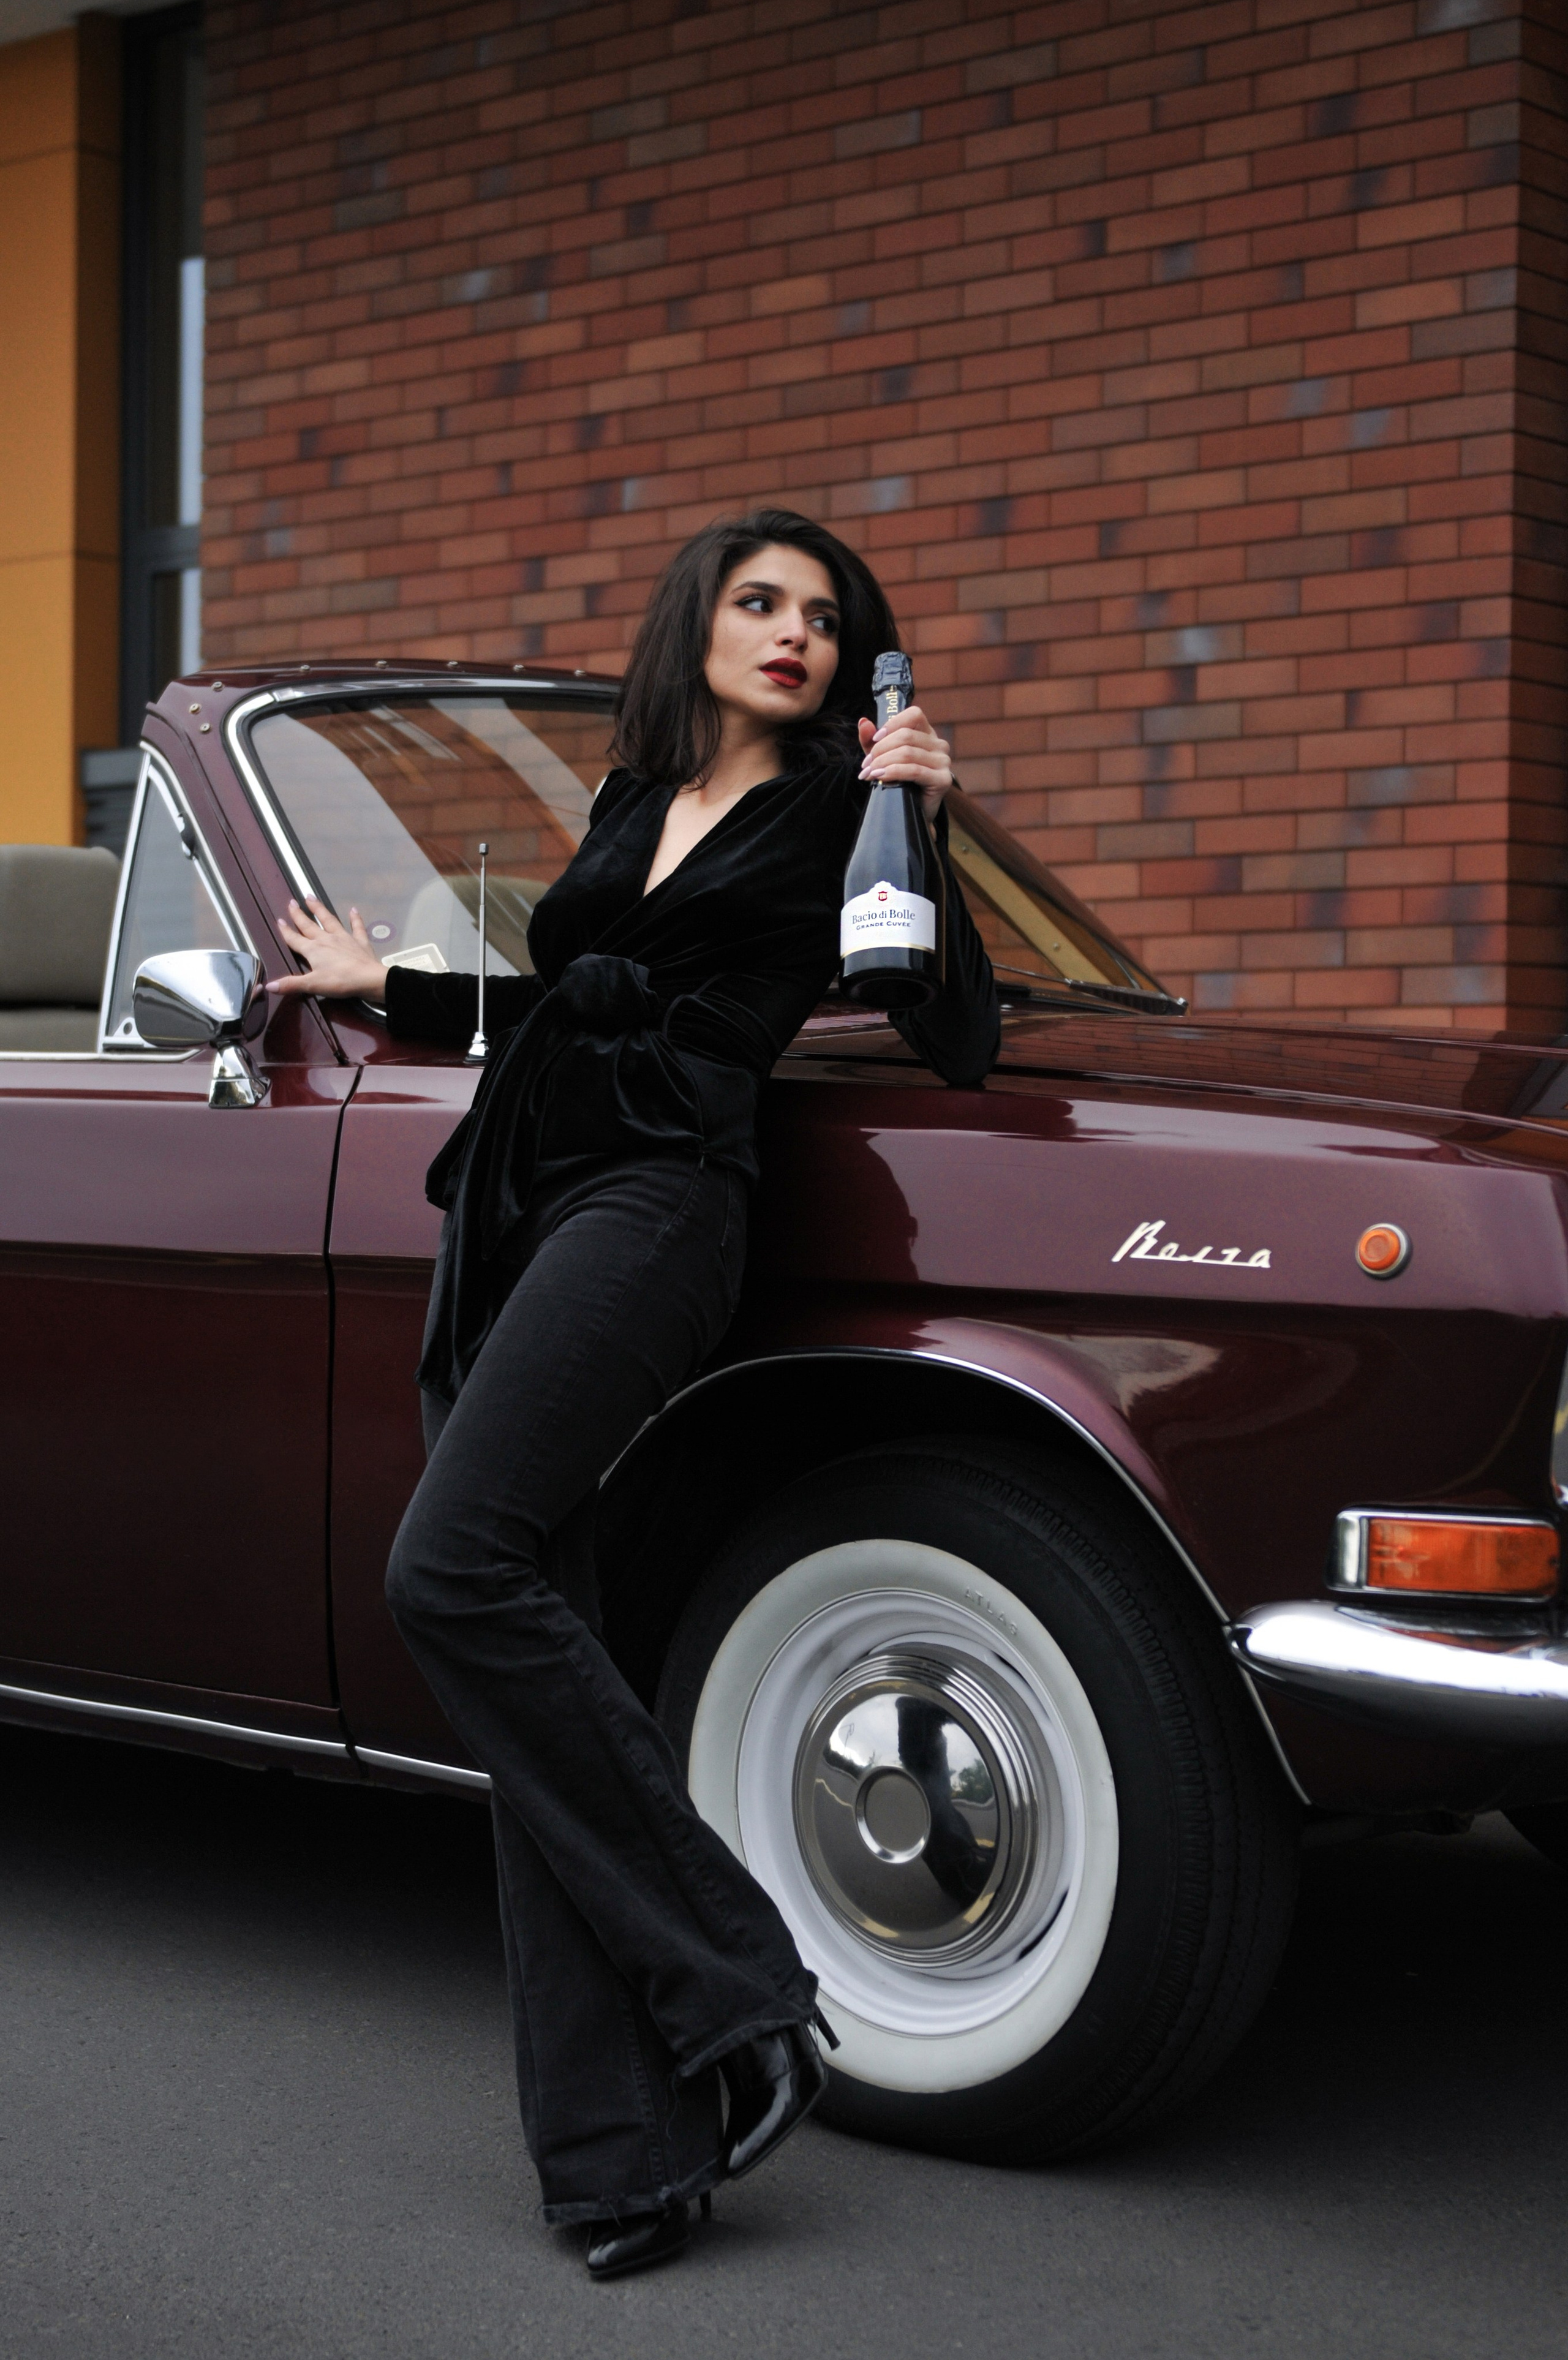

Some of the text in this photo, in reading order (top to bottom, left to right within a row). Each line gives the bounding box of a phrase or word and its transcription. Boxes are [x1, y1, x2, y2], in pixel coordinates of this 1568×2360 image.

[853, 911, 877, 924] Bacio
[889, 909, 916, 920] Bolle
[856, 922, 884, 930] GRANDE
